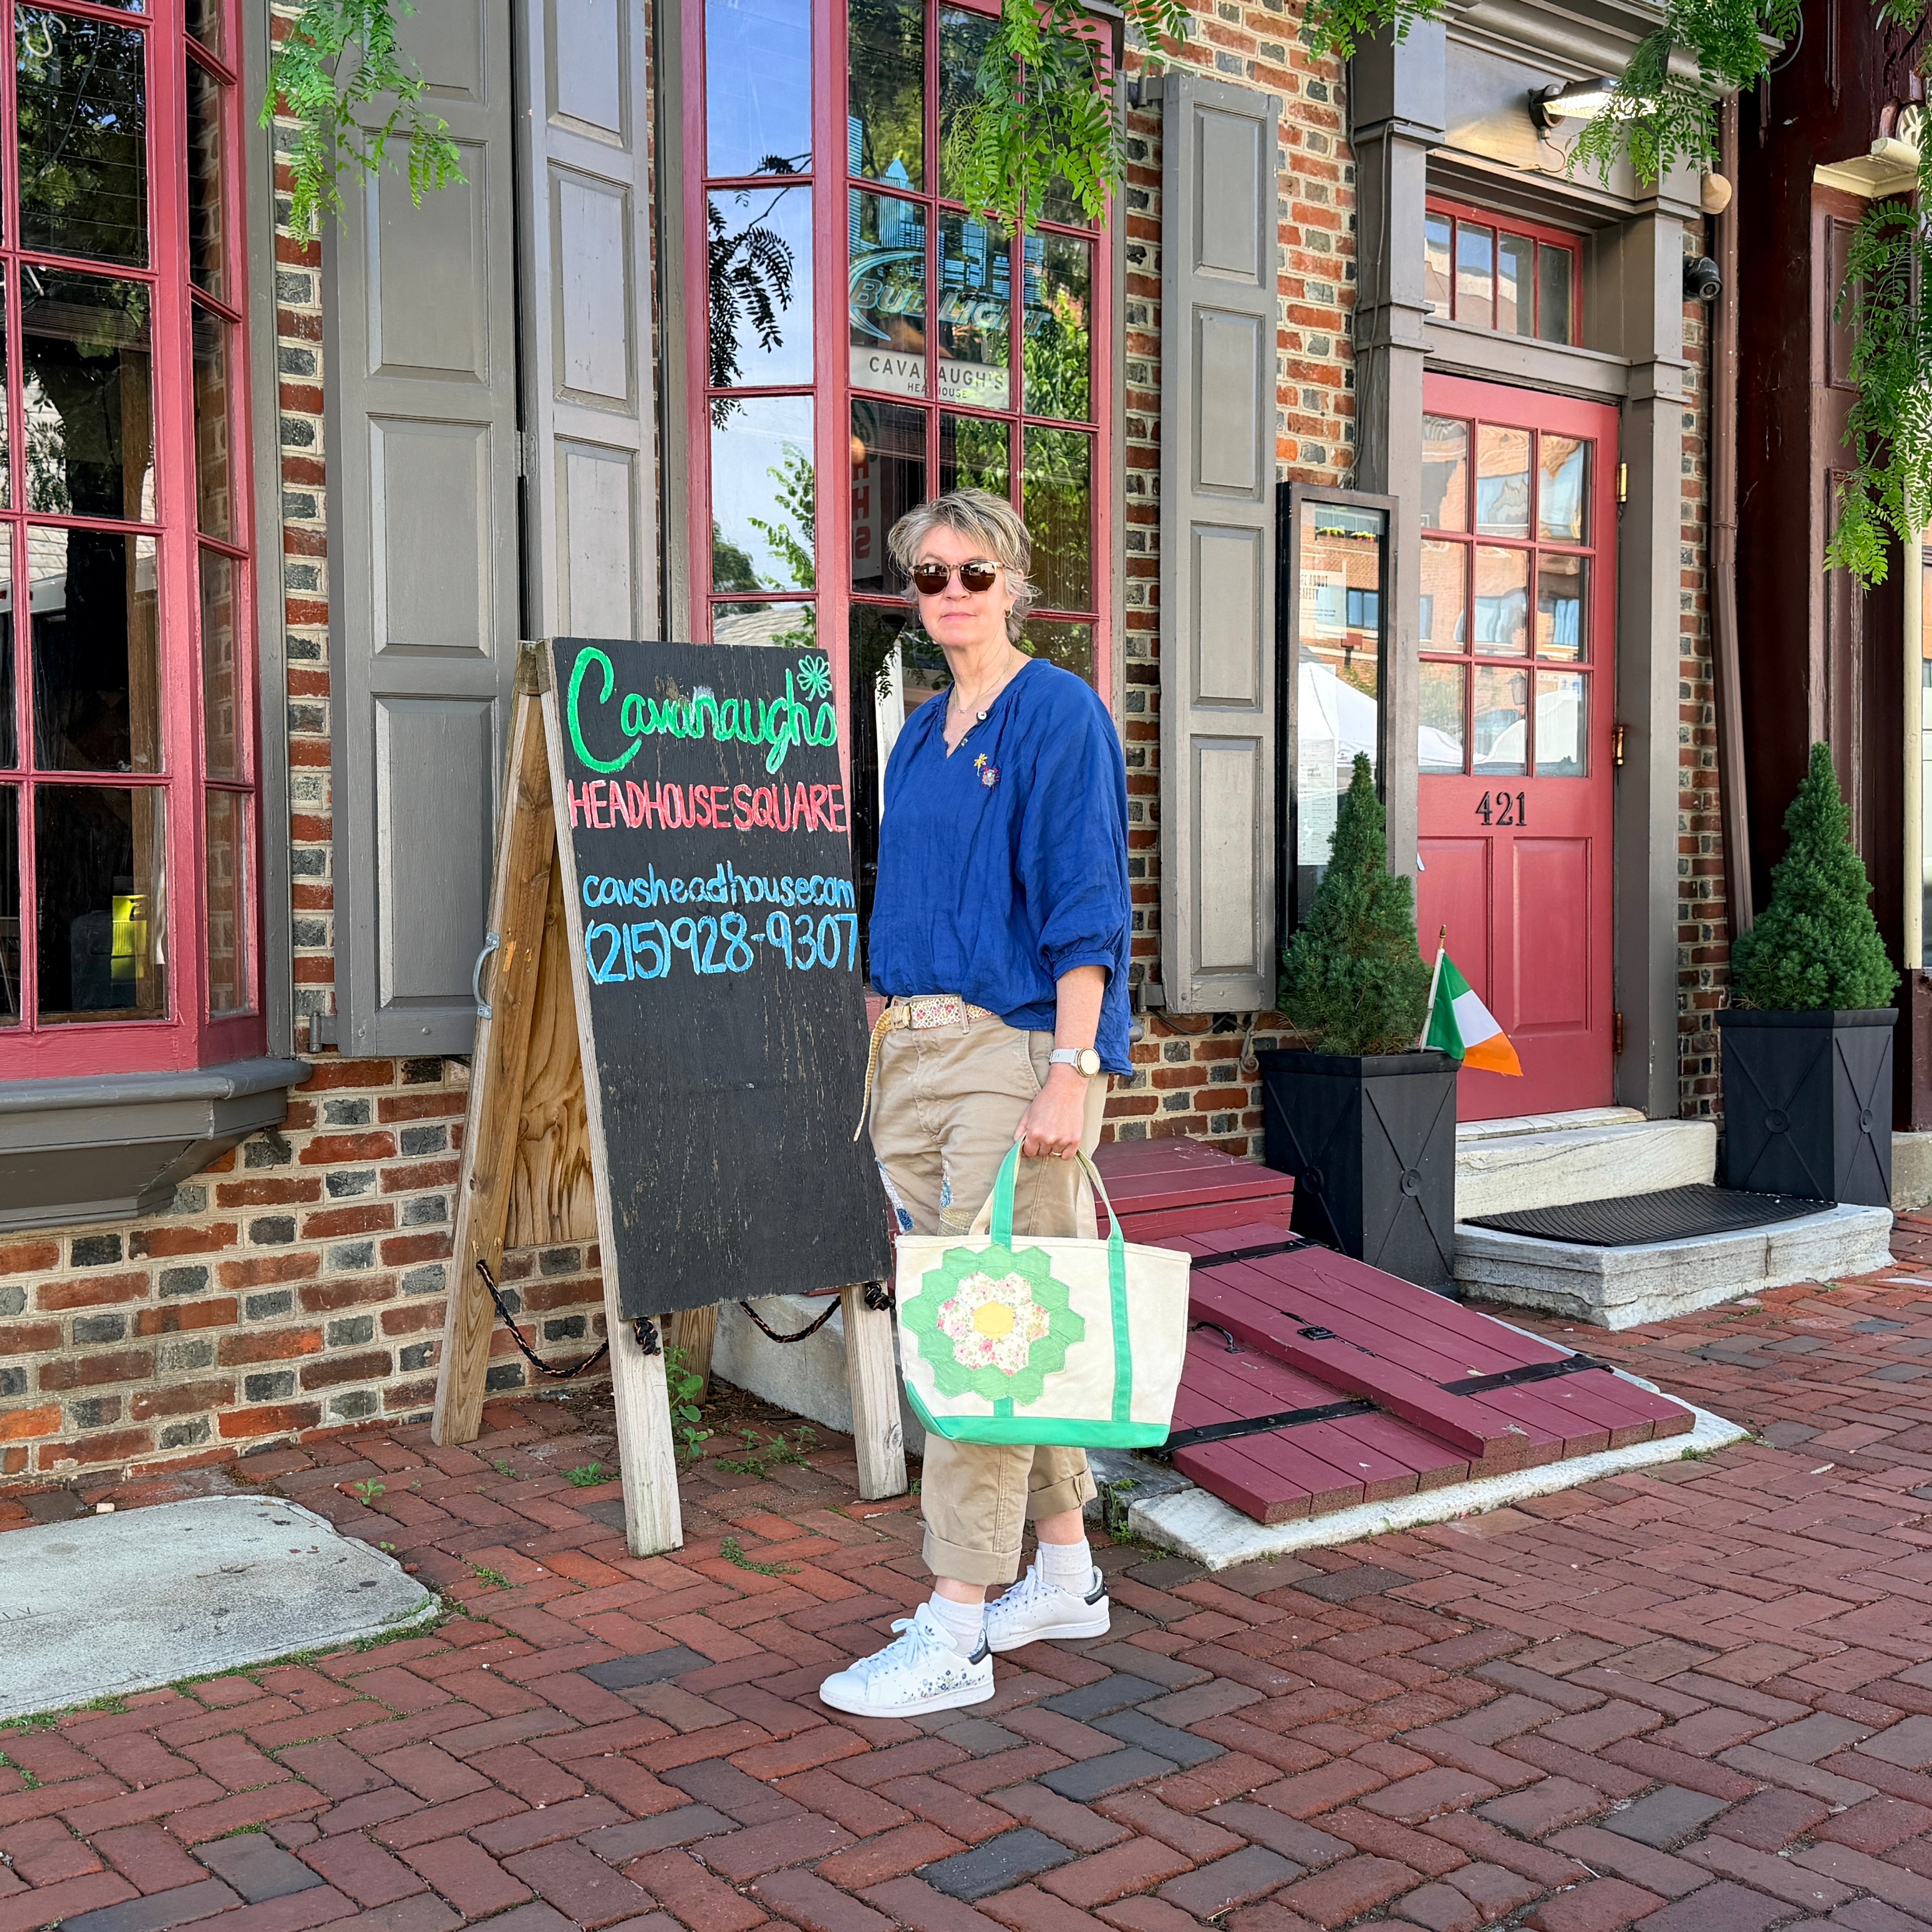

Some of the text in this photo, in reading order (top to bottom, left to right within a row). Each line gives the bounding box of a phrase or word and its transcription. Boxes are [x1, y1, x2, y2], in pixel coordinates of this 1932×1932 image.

[869, 356, 1004, 389] CAVAAUGH'S
[907, 382, 967, 398] HEAOUSE
[1300, 587, 1319, 600] AFETY
[1309, 575, 1328, 588] ABOUT
[568, 779, 848, 834] HEADHOUSE SQUARE
[1475, 791, 1527, 826] 421
